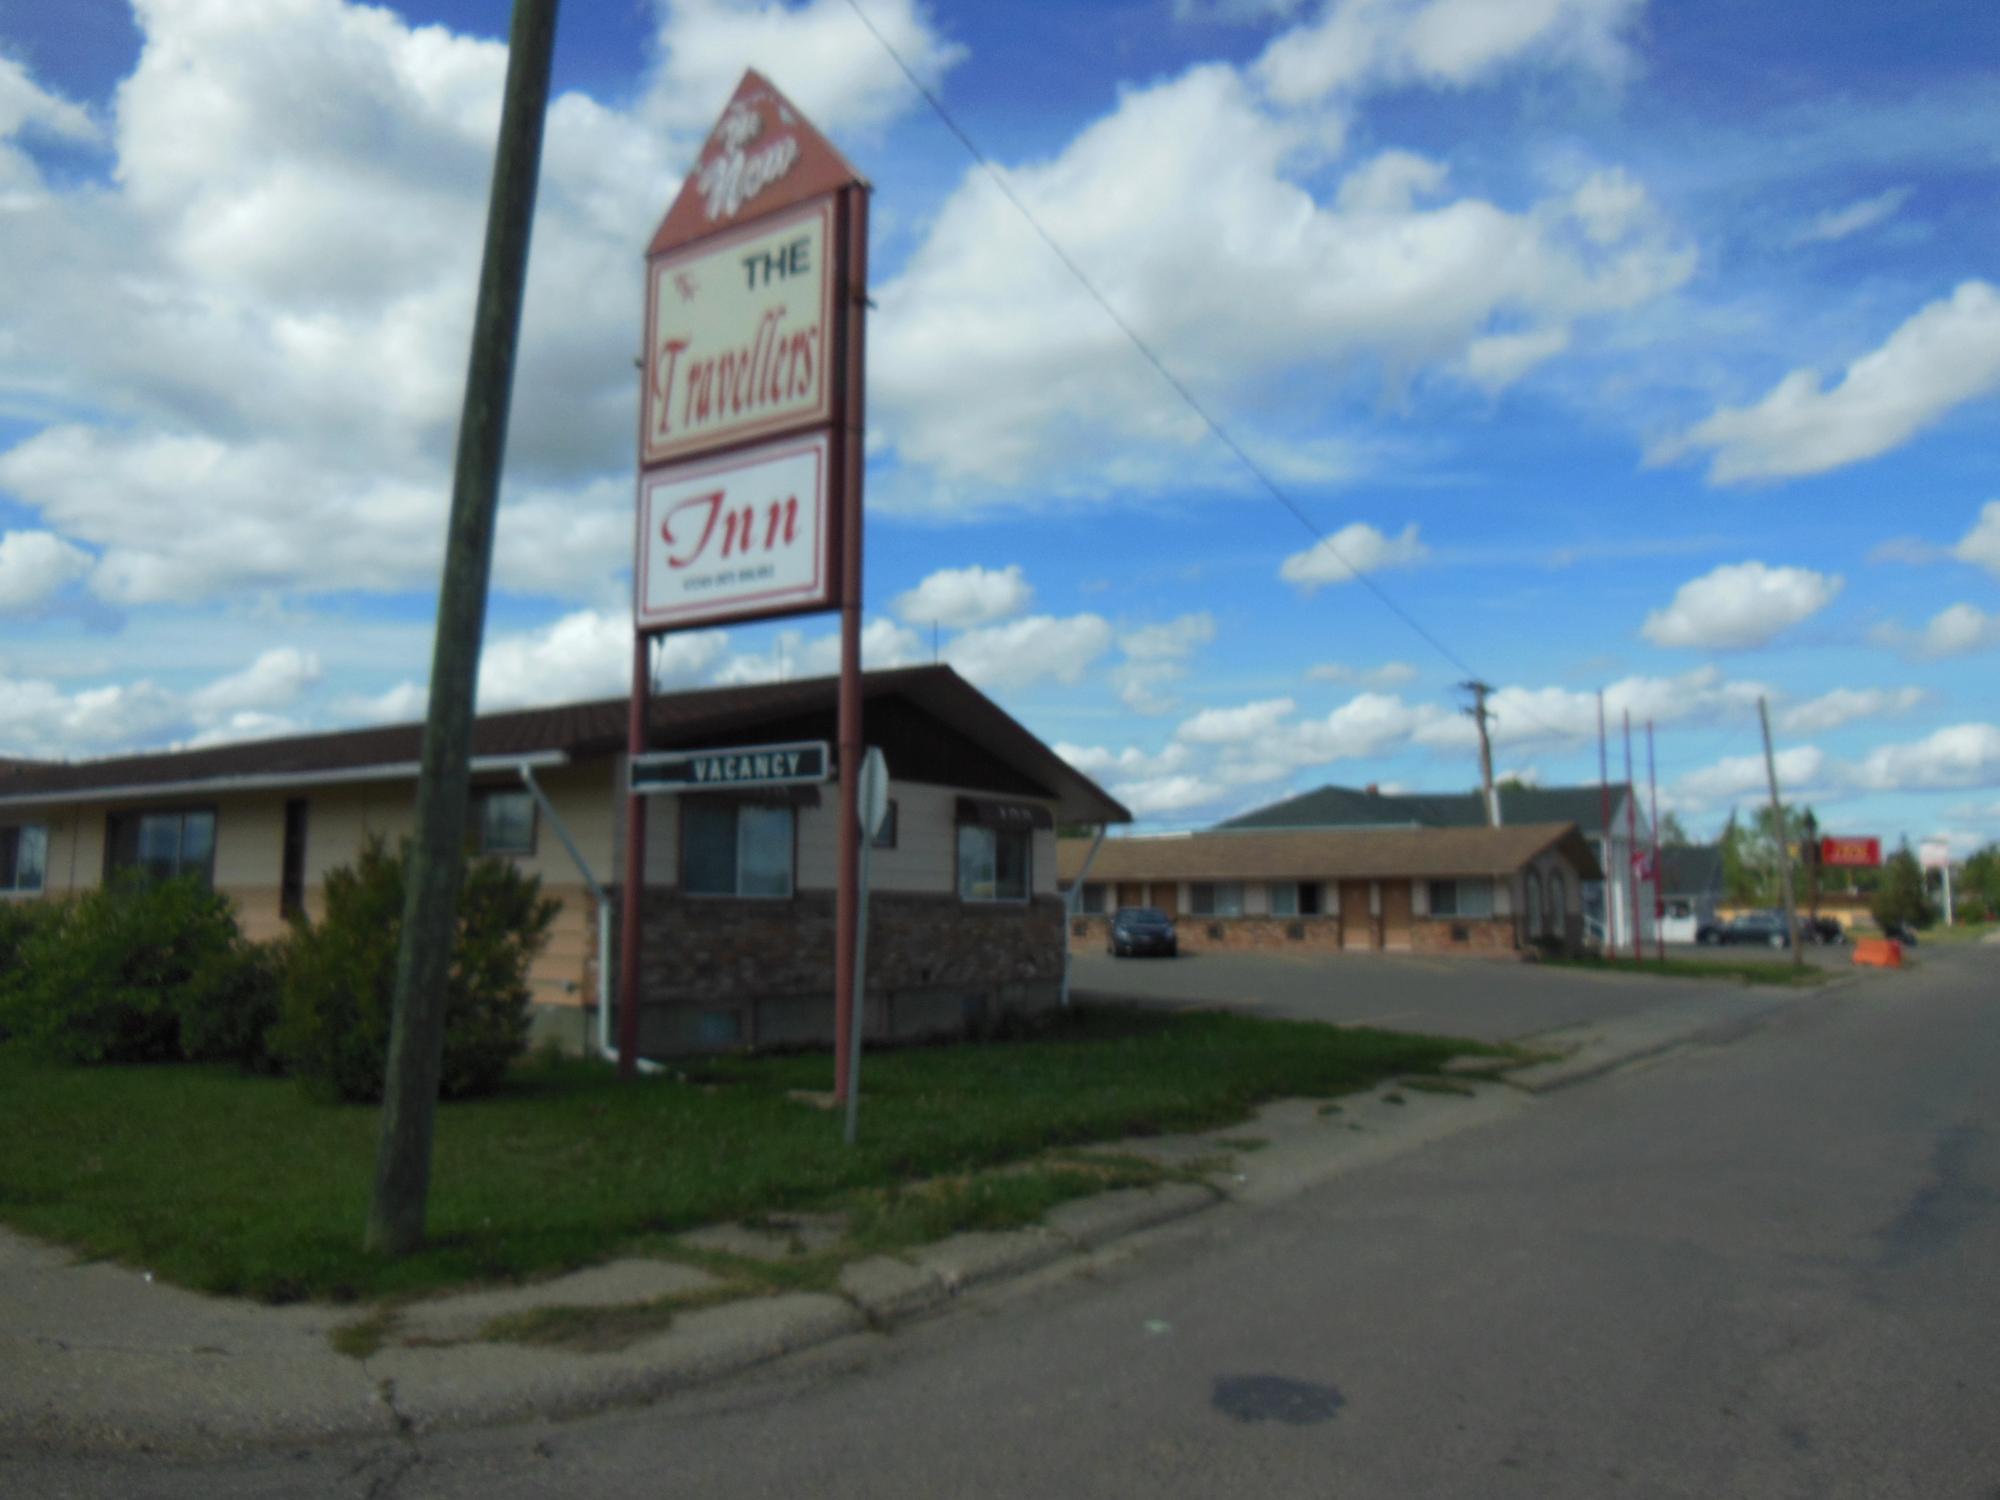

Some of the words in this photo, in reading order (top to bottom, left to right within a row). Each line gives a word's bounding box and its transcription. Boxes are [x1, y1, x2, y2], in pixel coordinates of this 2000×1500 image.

[742, 237, 811, 290] THE
[661, 489, 798, 569] Inn
[694, 752, 800, 782] VACANCY
